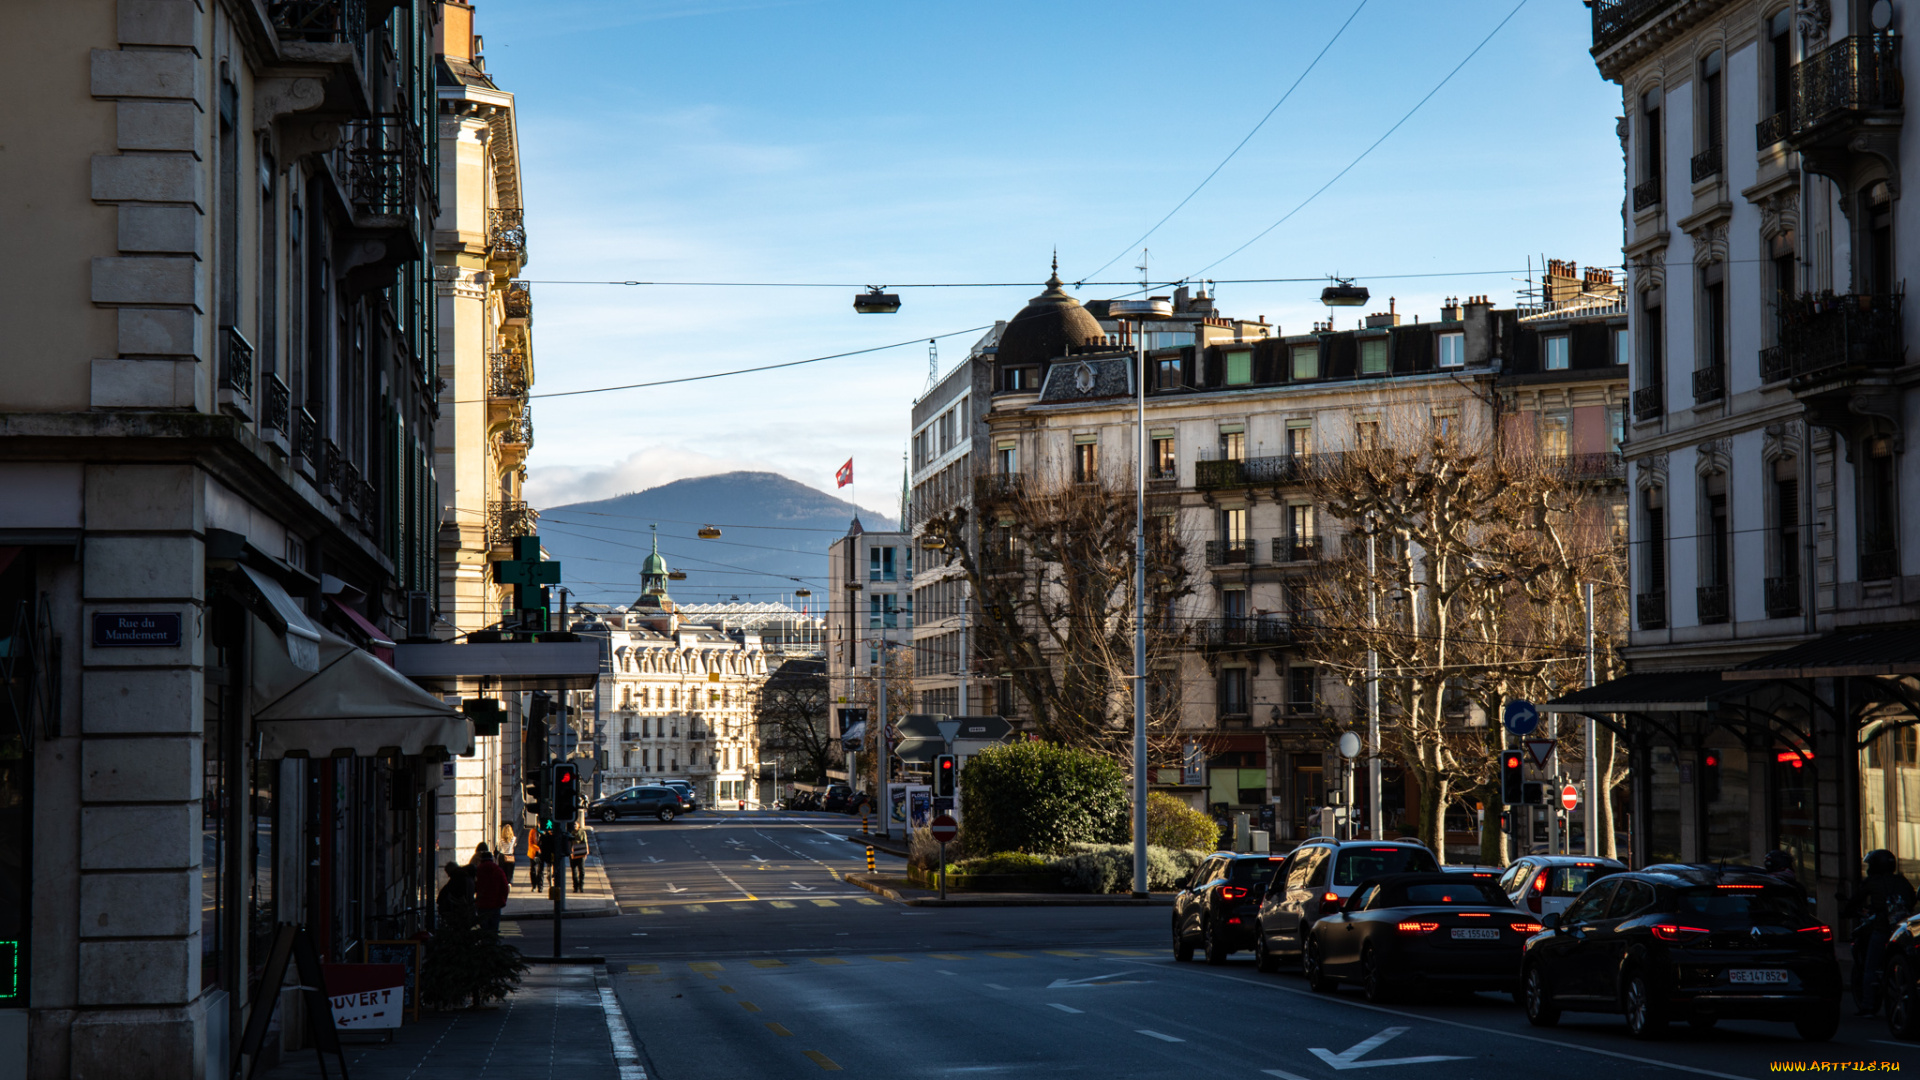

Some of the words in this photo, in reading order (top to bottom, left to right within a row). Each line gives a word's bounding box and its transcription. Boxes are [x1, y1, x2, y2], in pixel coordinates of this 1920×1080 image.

[118, 617, 139, 628] Rue
[141, 617, 156, 628] du
[105, 629, 168, 640] Mandement
